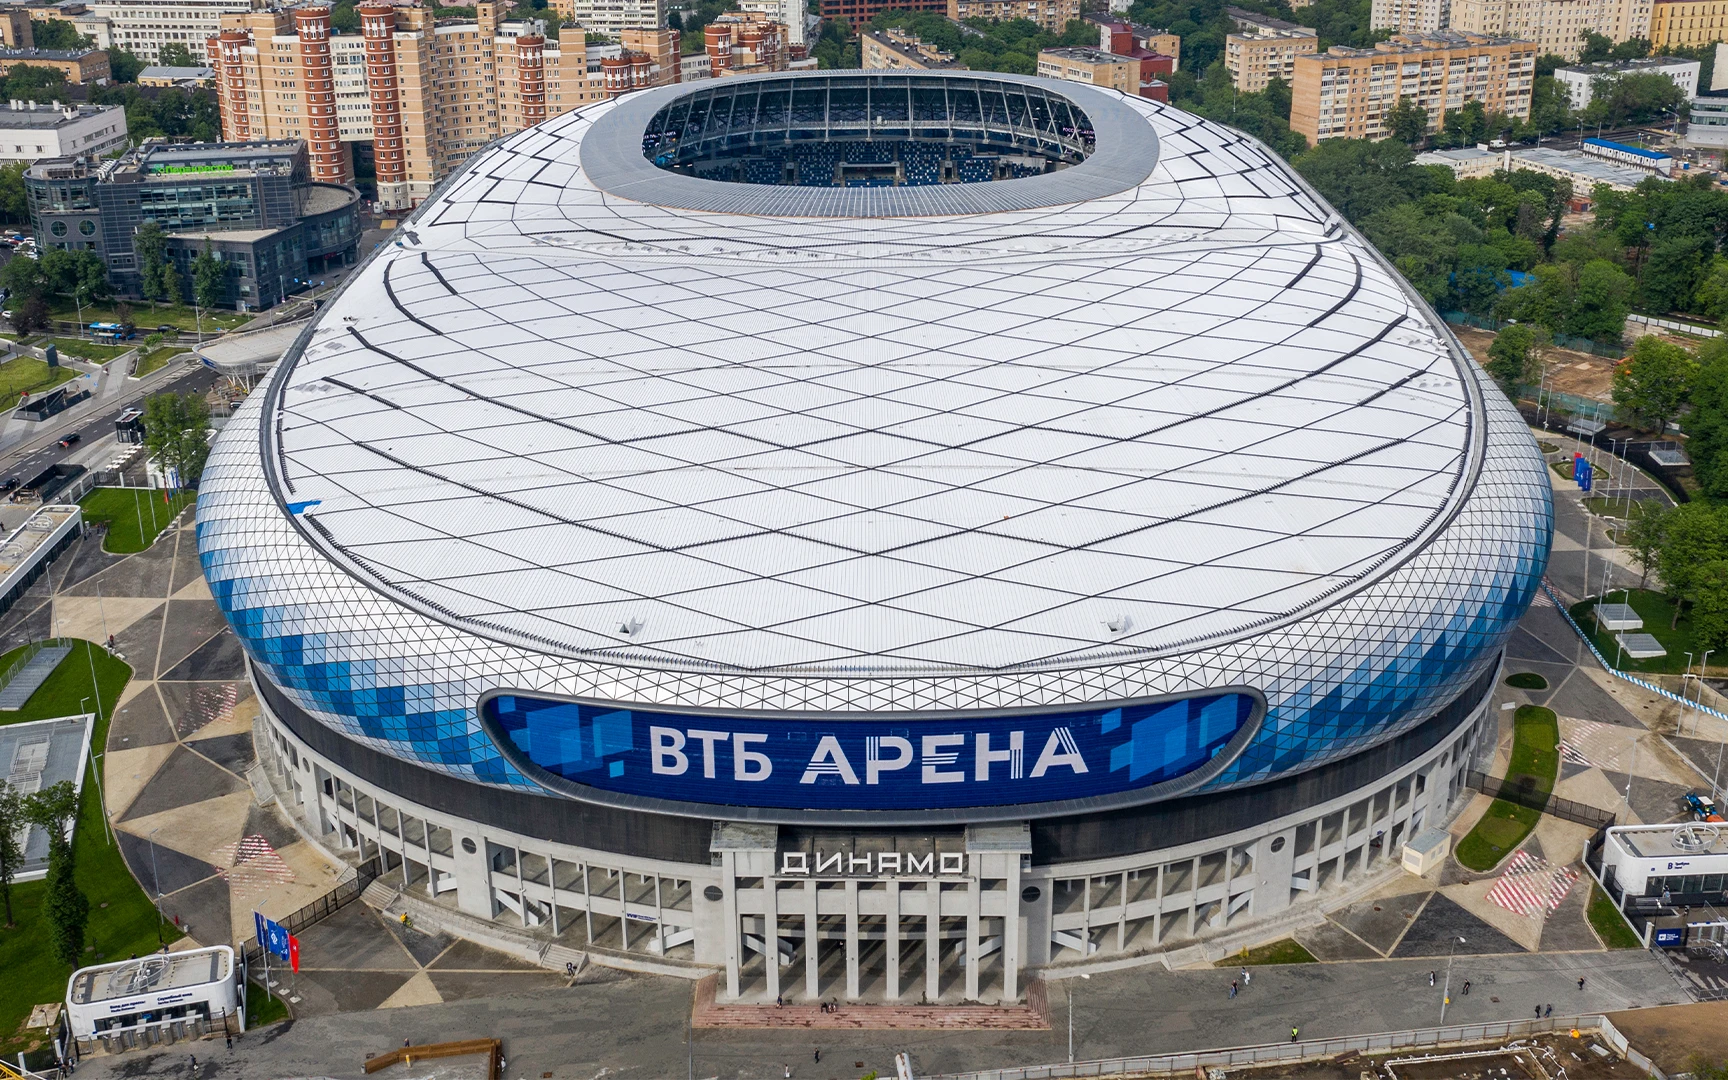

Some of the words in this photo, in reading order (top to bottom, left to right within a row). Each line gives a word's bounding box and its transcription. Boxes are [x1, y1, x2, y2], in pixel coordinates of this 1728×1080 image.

[650, 725, 773, 781] ВТБ
[800, 726, 1089, 785] АРЕНА
[781, 852, 963, 874] ДИНАМО
